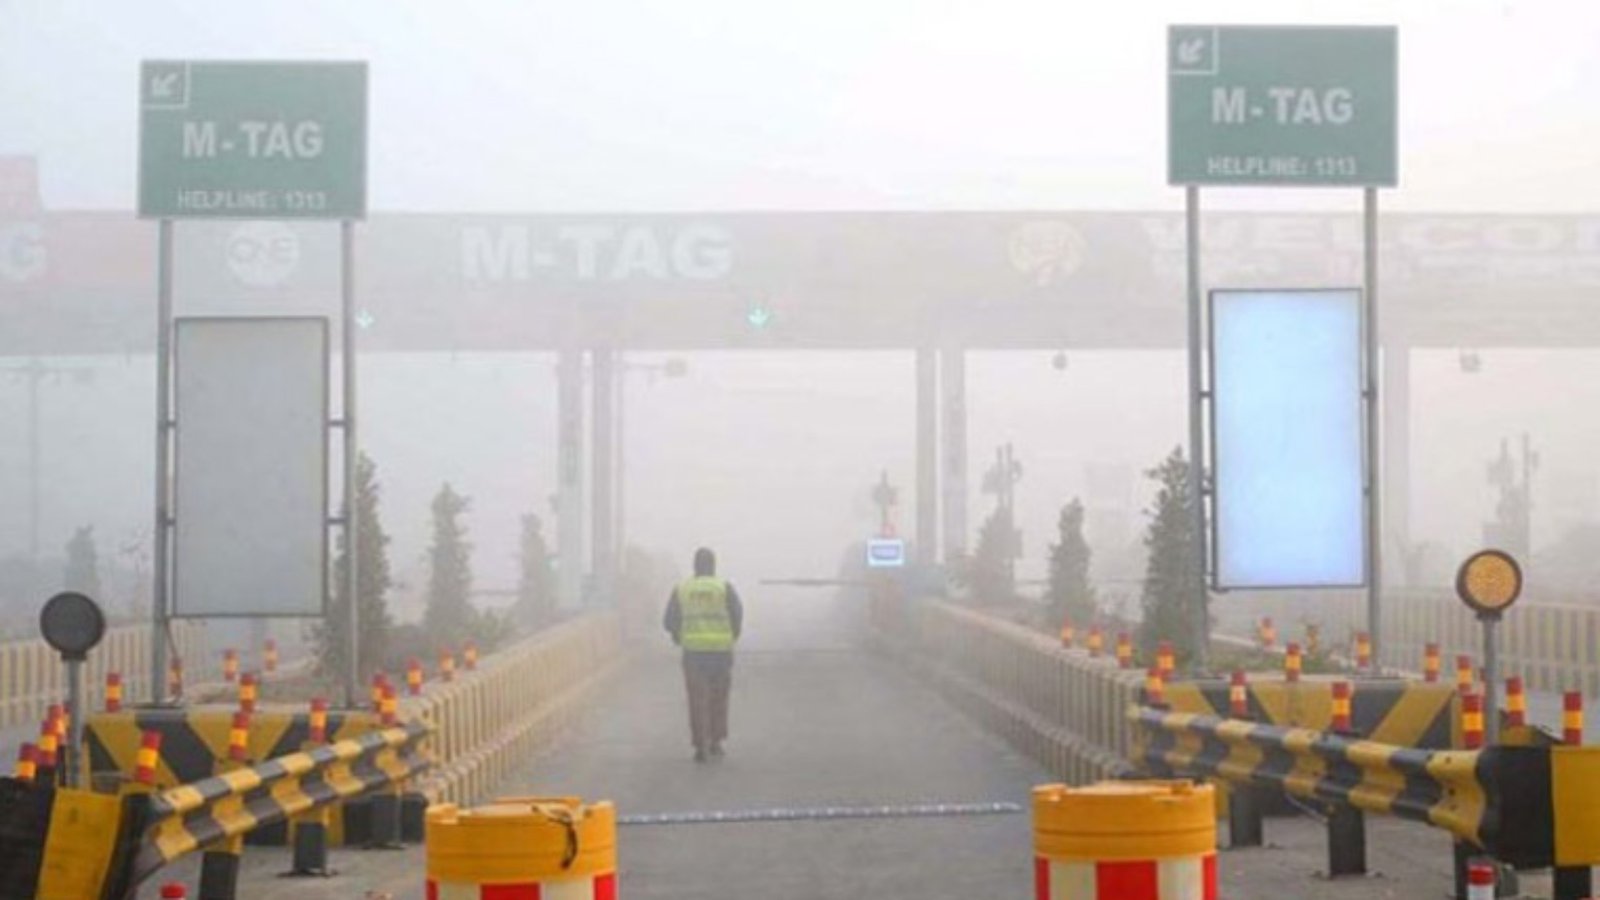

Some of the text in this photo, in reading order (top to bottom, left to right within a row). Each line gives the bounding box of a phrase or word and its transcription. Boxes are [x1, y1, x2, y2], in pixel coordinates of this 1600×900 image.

[1211, 86, 1354, 125] M-TAG
[182, 120, 324, 159] M-TAG
[461, 223, 733, 280] M-TAG
